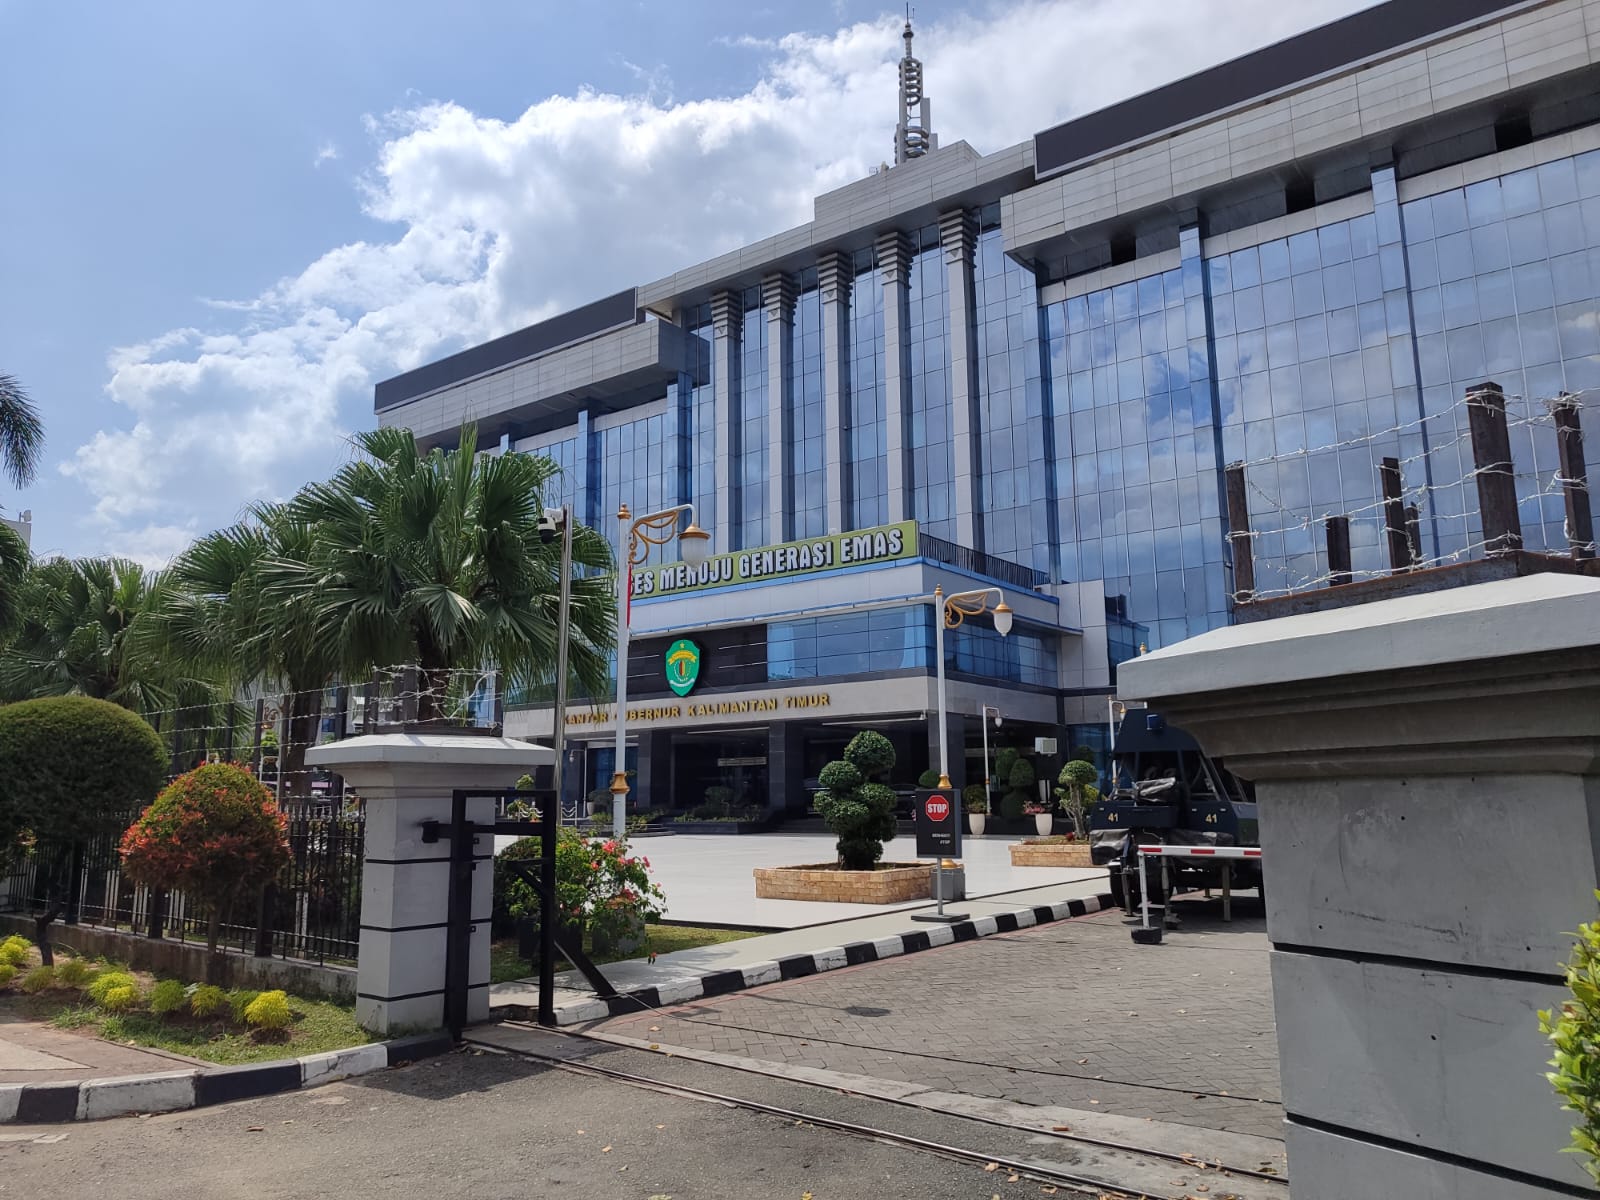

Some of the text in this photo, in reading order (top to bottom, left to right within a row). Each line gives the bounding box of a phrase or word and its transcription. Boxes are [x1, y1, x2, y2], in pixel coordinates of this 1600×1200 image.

[660, 557, 733, 591] MENUJU
[739, 541, 833, 578] GENERASI
[840, 528, 903, 563] EMAS
[687, 698, 777, 717] KALIMANTAN
[784, 693, 830, 709] TIMUR
[927, 803, 947, 814] STOP
[1107, 812, 1119, 823] 41
[1205, 813, 1218, 824] 41
